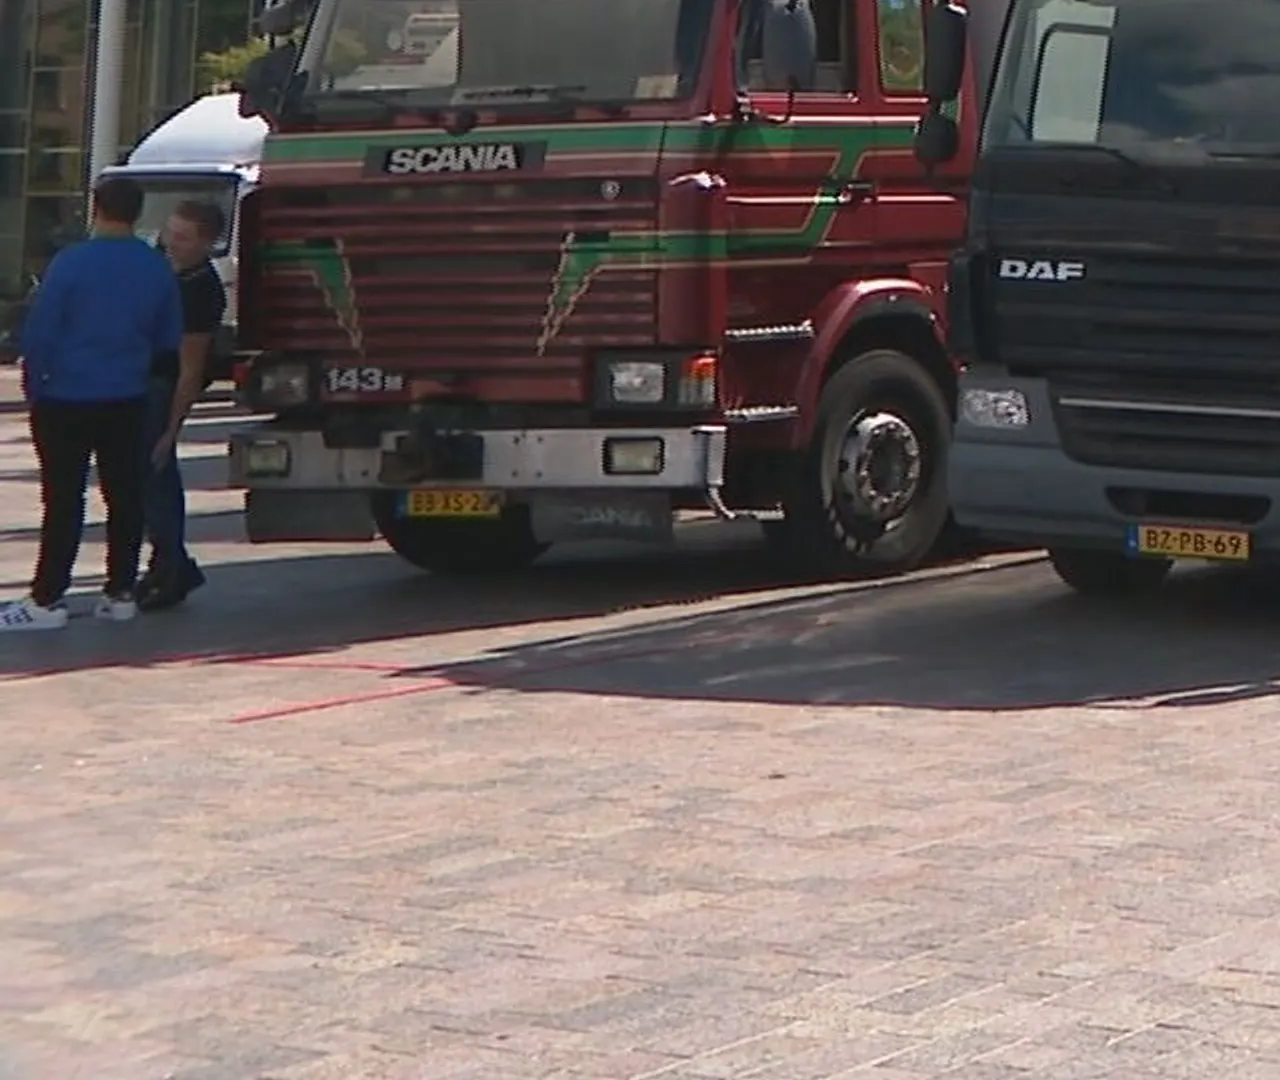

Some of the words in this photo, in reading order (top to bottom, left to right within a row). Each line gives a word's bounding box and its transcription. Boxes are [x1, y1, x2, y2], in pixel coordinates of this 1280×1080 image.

[388, 144, 517, 173] SCANIA
[999, 259, 1084, 280] DAF
[1145, 528, 1242, 555] BZ-PB-69
